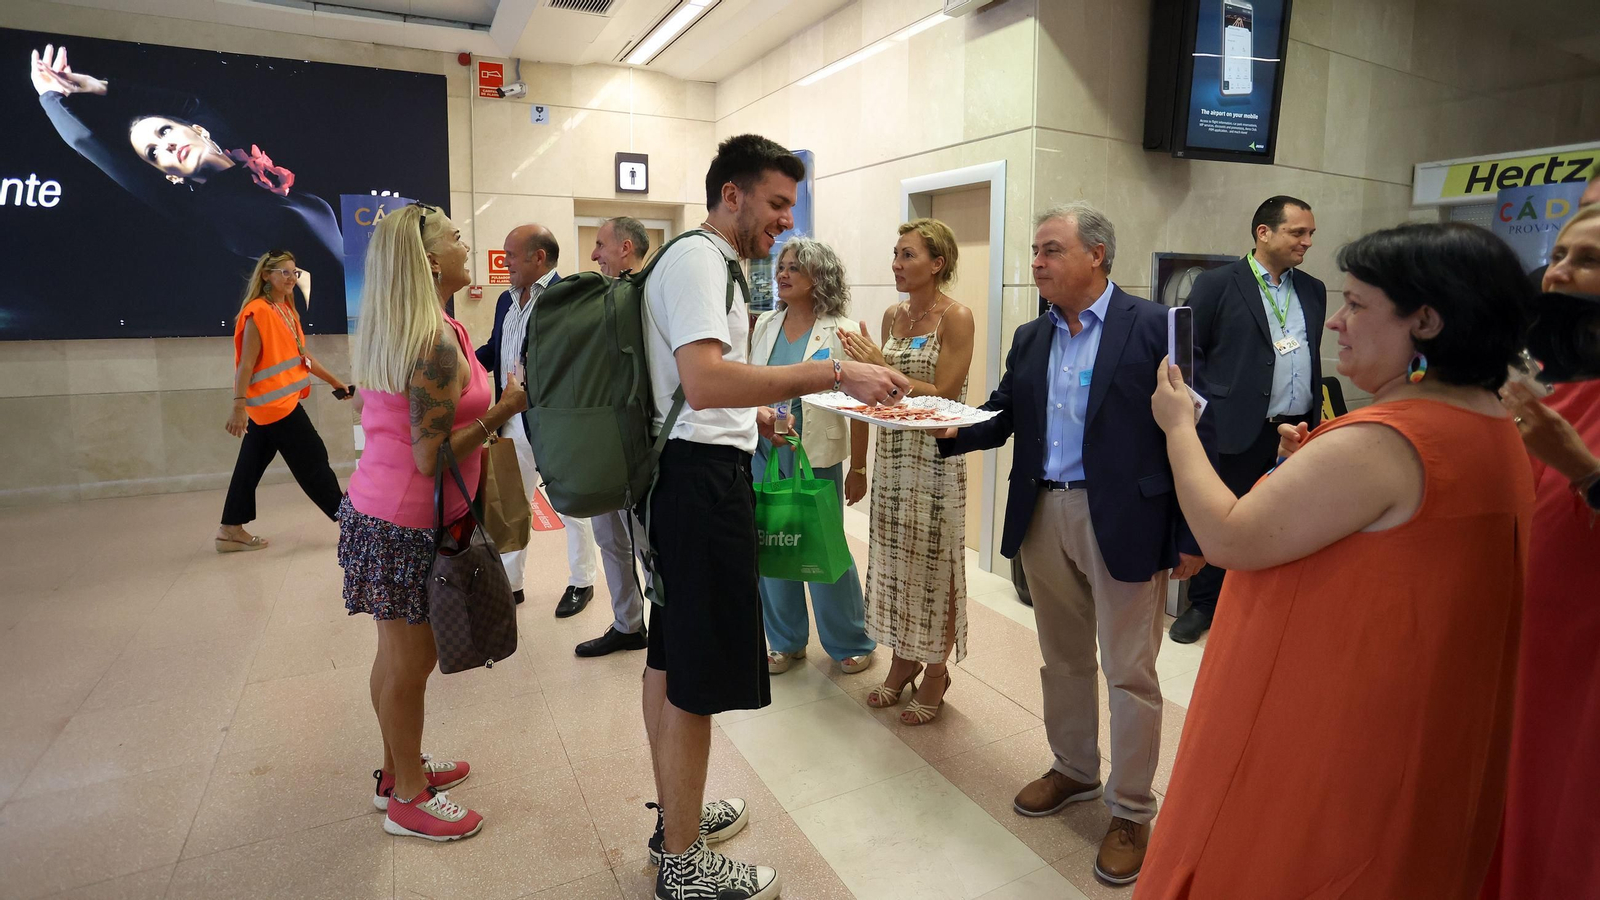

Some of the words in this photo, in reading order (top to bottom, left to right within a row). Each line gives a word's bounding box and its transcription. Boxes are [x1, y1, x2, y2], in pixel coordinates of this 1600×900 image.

[1464, 156, 1594, 193] Hertz
[0, 173, 61, 207] nte
[1508, 222, 1562, 235] PROVIN
[1287, 340, 1298, 348] 26
[757, 529, 802, 547] Binter
